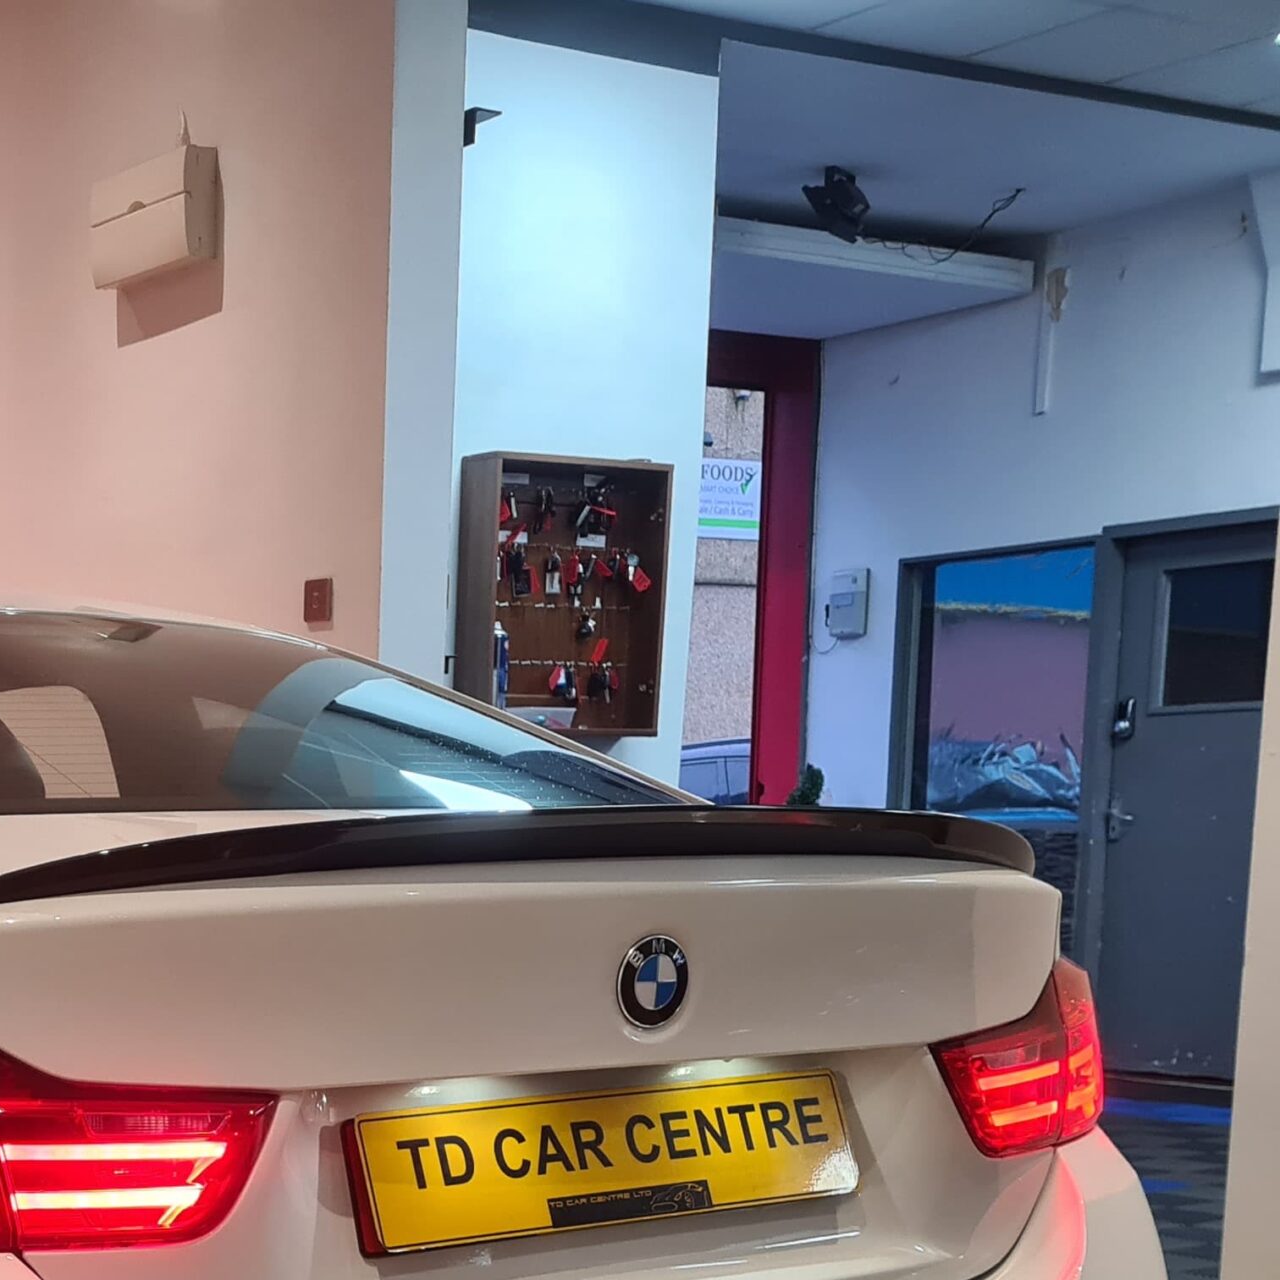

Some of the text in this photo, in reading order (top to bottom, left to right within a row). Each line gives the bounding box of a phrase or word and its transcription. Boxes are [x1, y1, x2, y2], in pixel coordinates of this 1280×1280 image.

[701, 464, 754, 481] FOODS
[629, 938, 685, 968] BMW
[396, 1097, 829, 1190] TD CAR CENTRE
[549, 1190, 653, 1209] TD CAR CENTRE LTD
